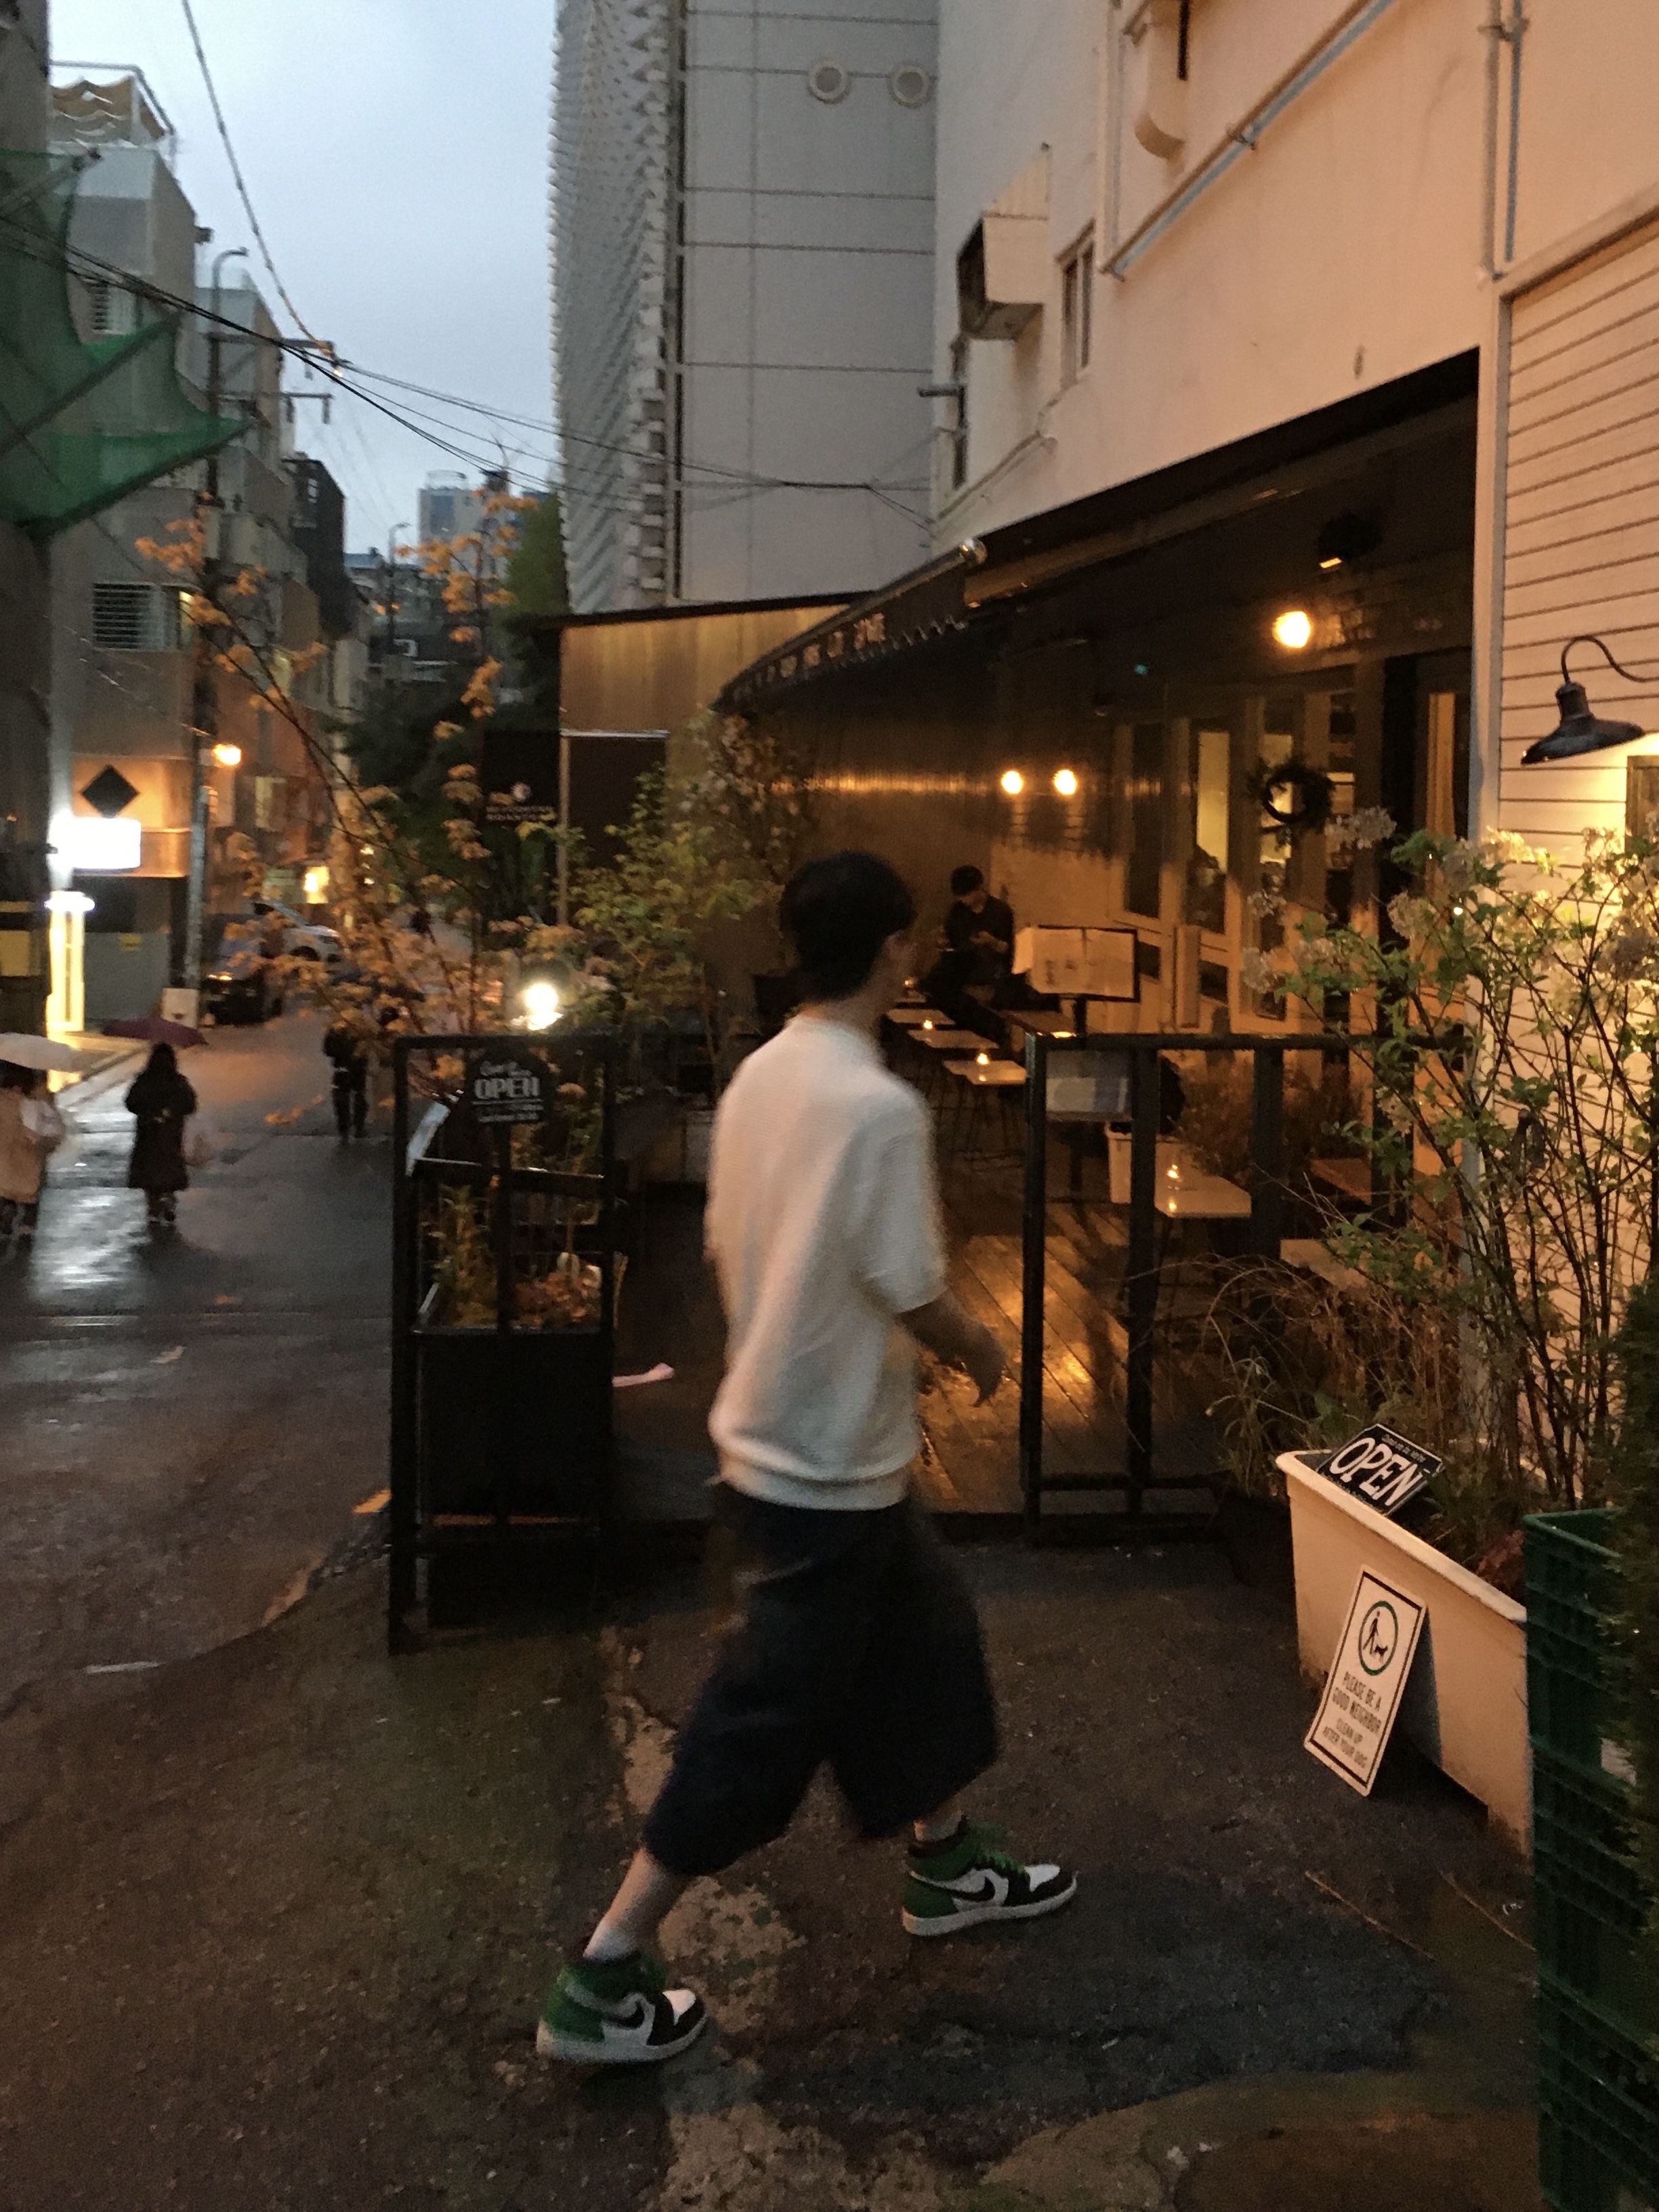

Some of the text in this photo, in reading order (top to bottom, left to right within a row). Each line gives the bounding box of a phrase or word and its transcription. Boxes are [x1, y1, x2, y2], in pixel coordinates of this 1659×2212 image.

[475, 1077, 540, 1099] OPEN
[1330, 1437, 1423, 1506] OPEN
[1332, 1687, 1382, 1735] GOOD NEIGHBOR
[1343, 1671, 1381, 1711] PLEASE BE A
